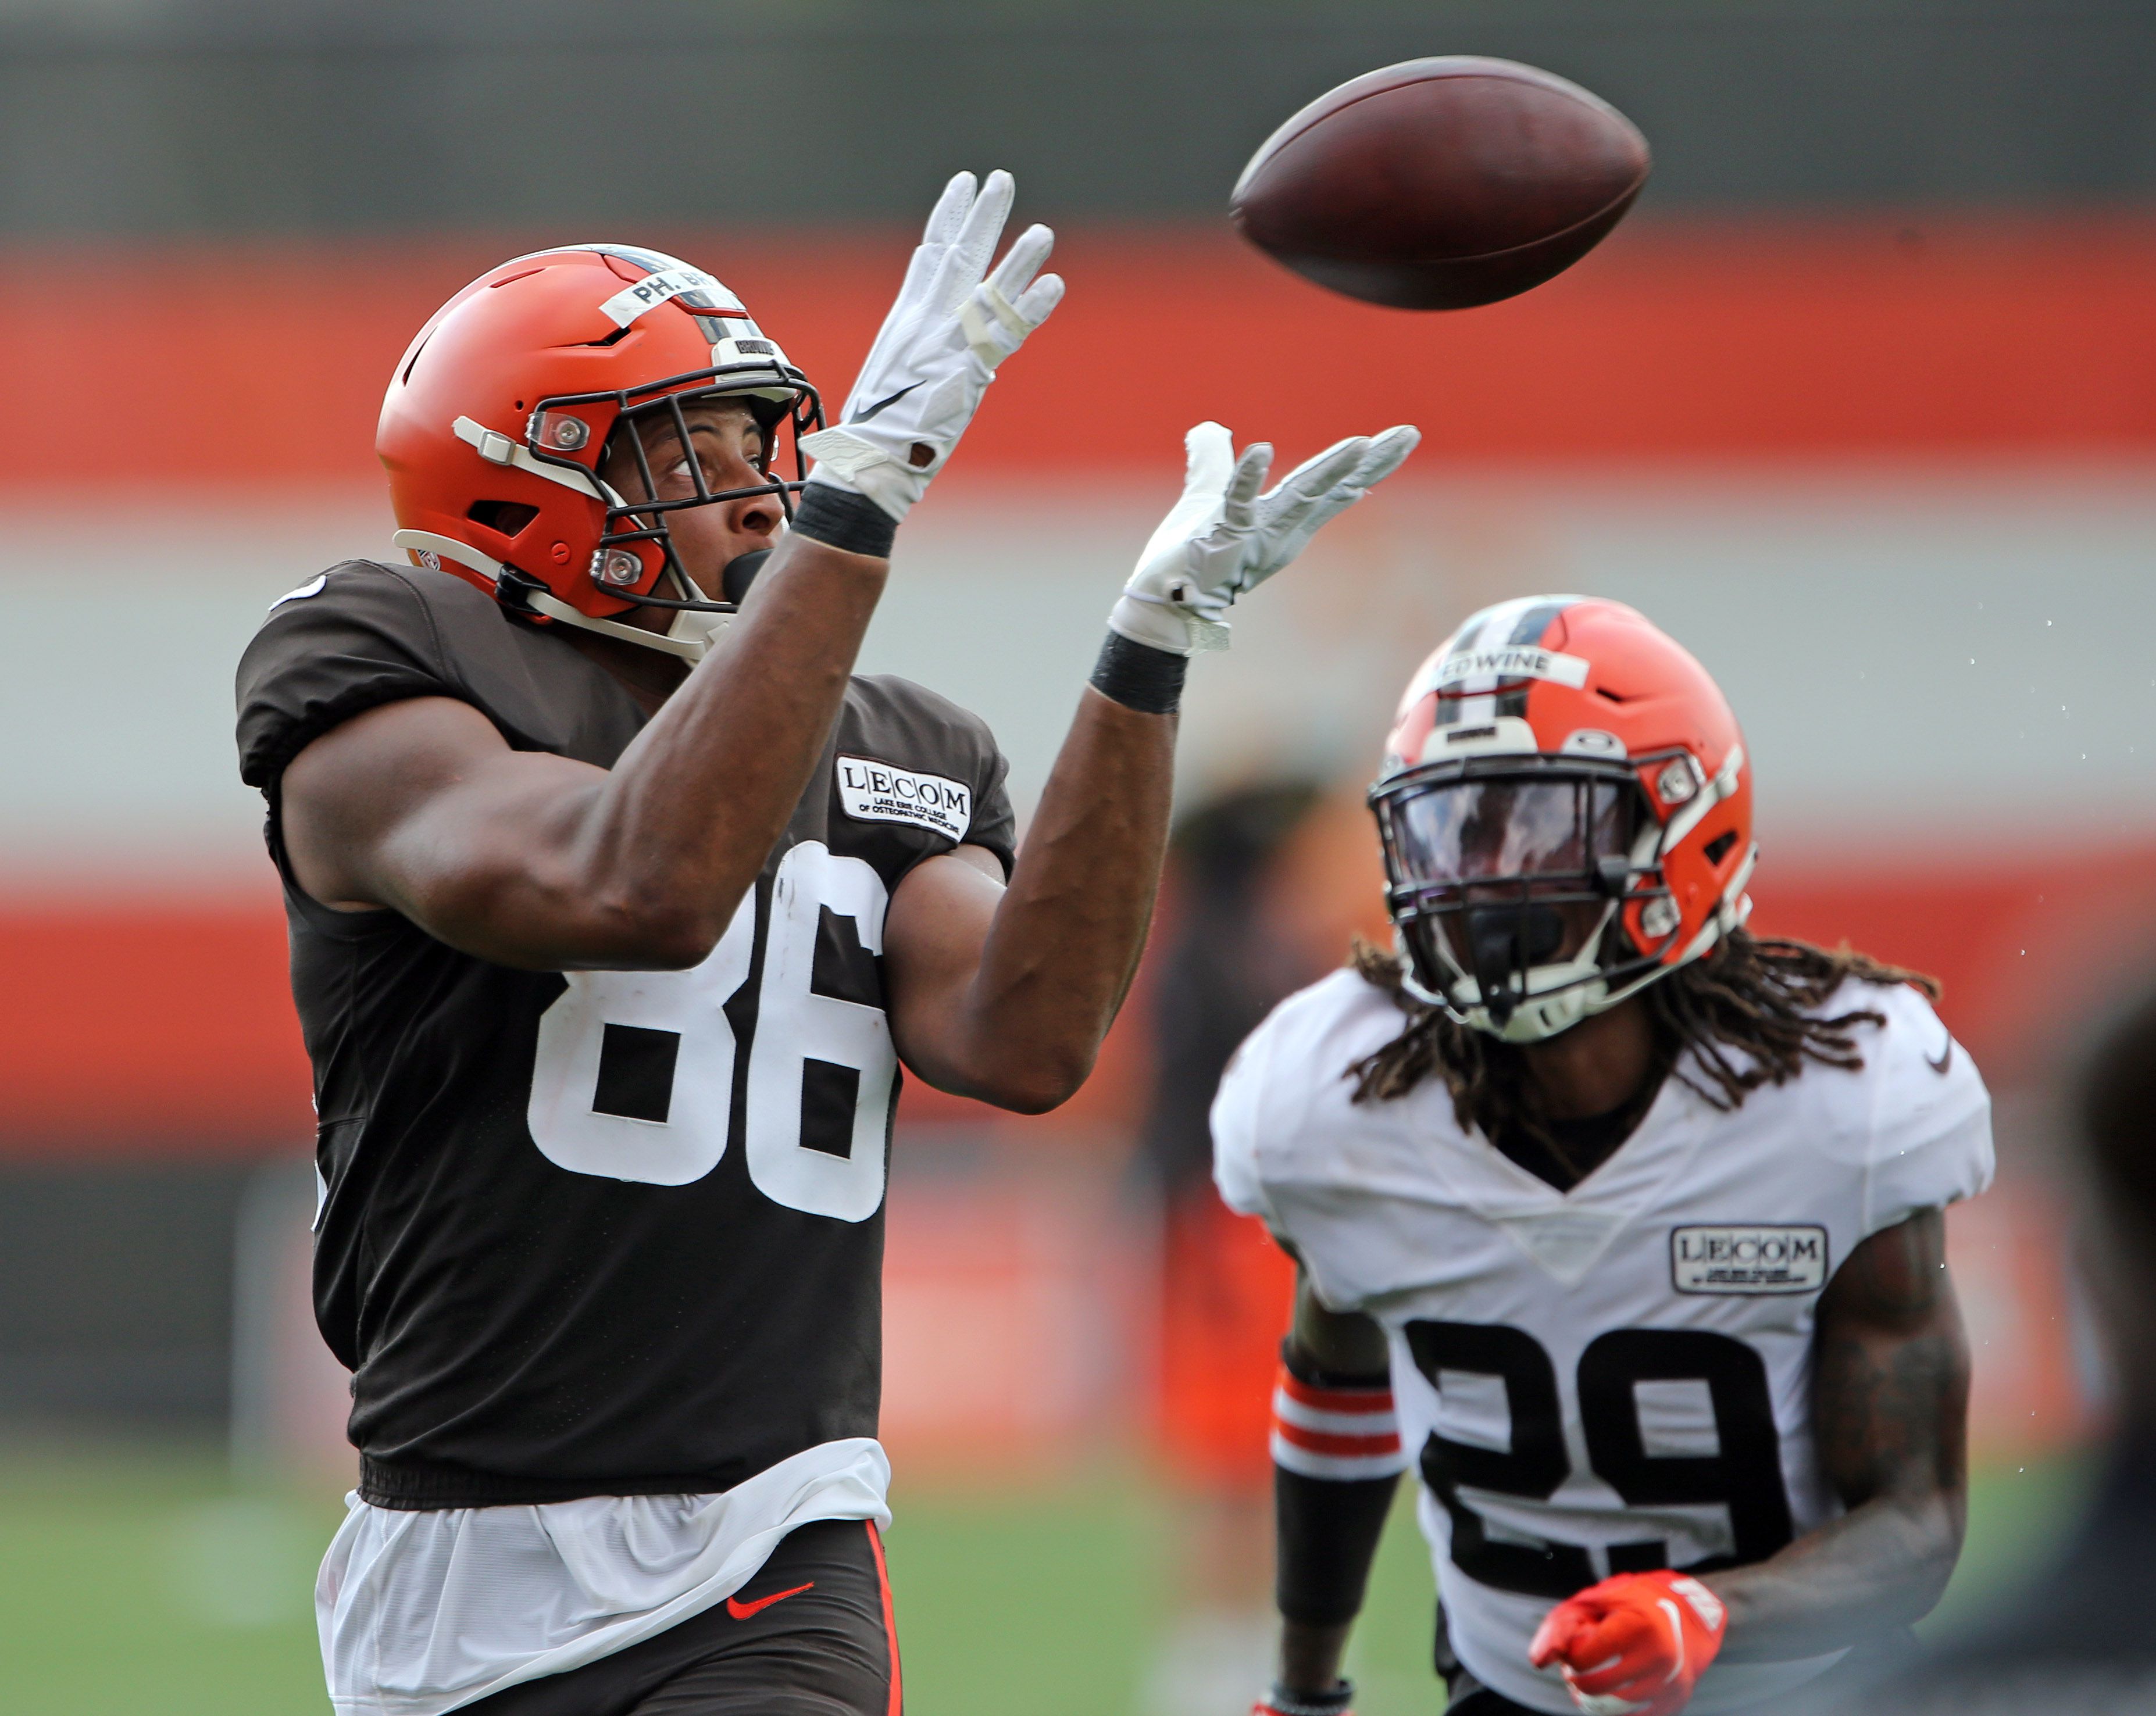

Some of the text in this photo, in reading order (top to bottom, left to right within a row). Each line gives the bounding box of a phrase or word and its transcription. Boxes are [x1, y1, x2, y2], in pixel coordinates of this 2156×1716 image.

[633, 276, 681, 304] PH.
[1442, 653, 1550, 678] EDWINE
[844, 766, 968, 817] LECOM
[874, 797, 894, 807] LAKE
[859, 804, 870, 812] OF
[527, 840, 898, 1223] 86
[1681, 1235, 1818, 1261] LECOM
[1404, 1319, 1793, 1600] 29
